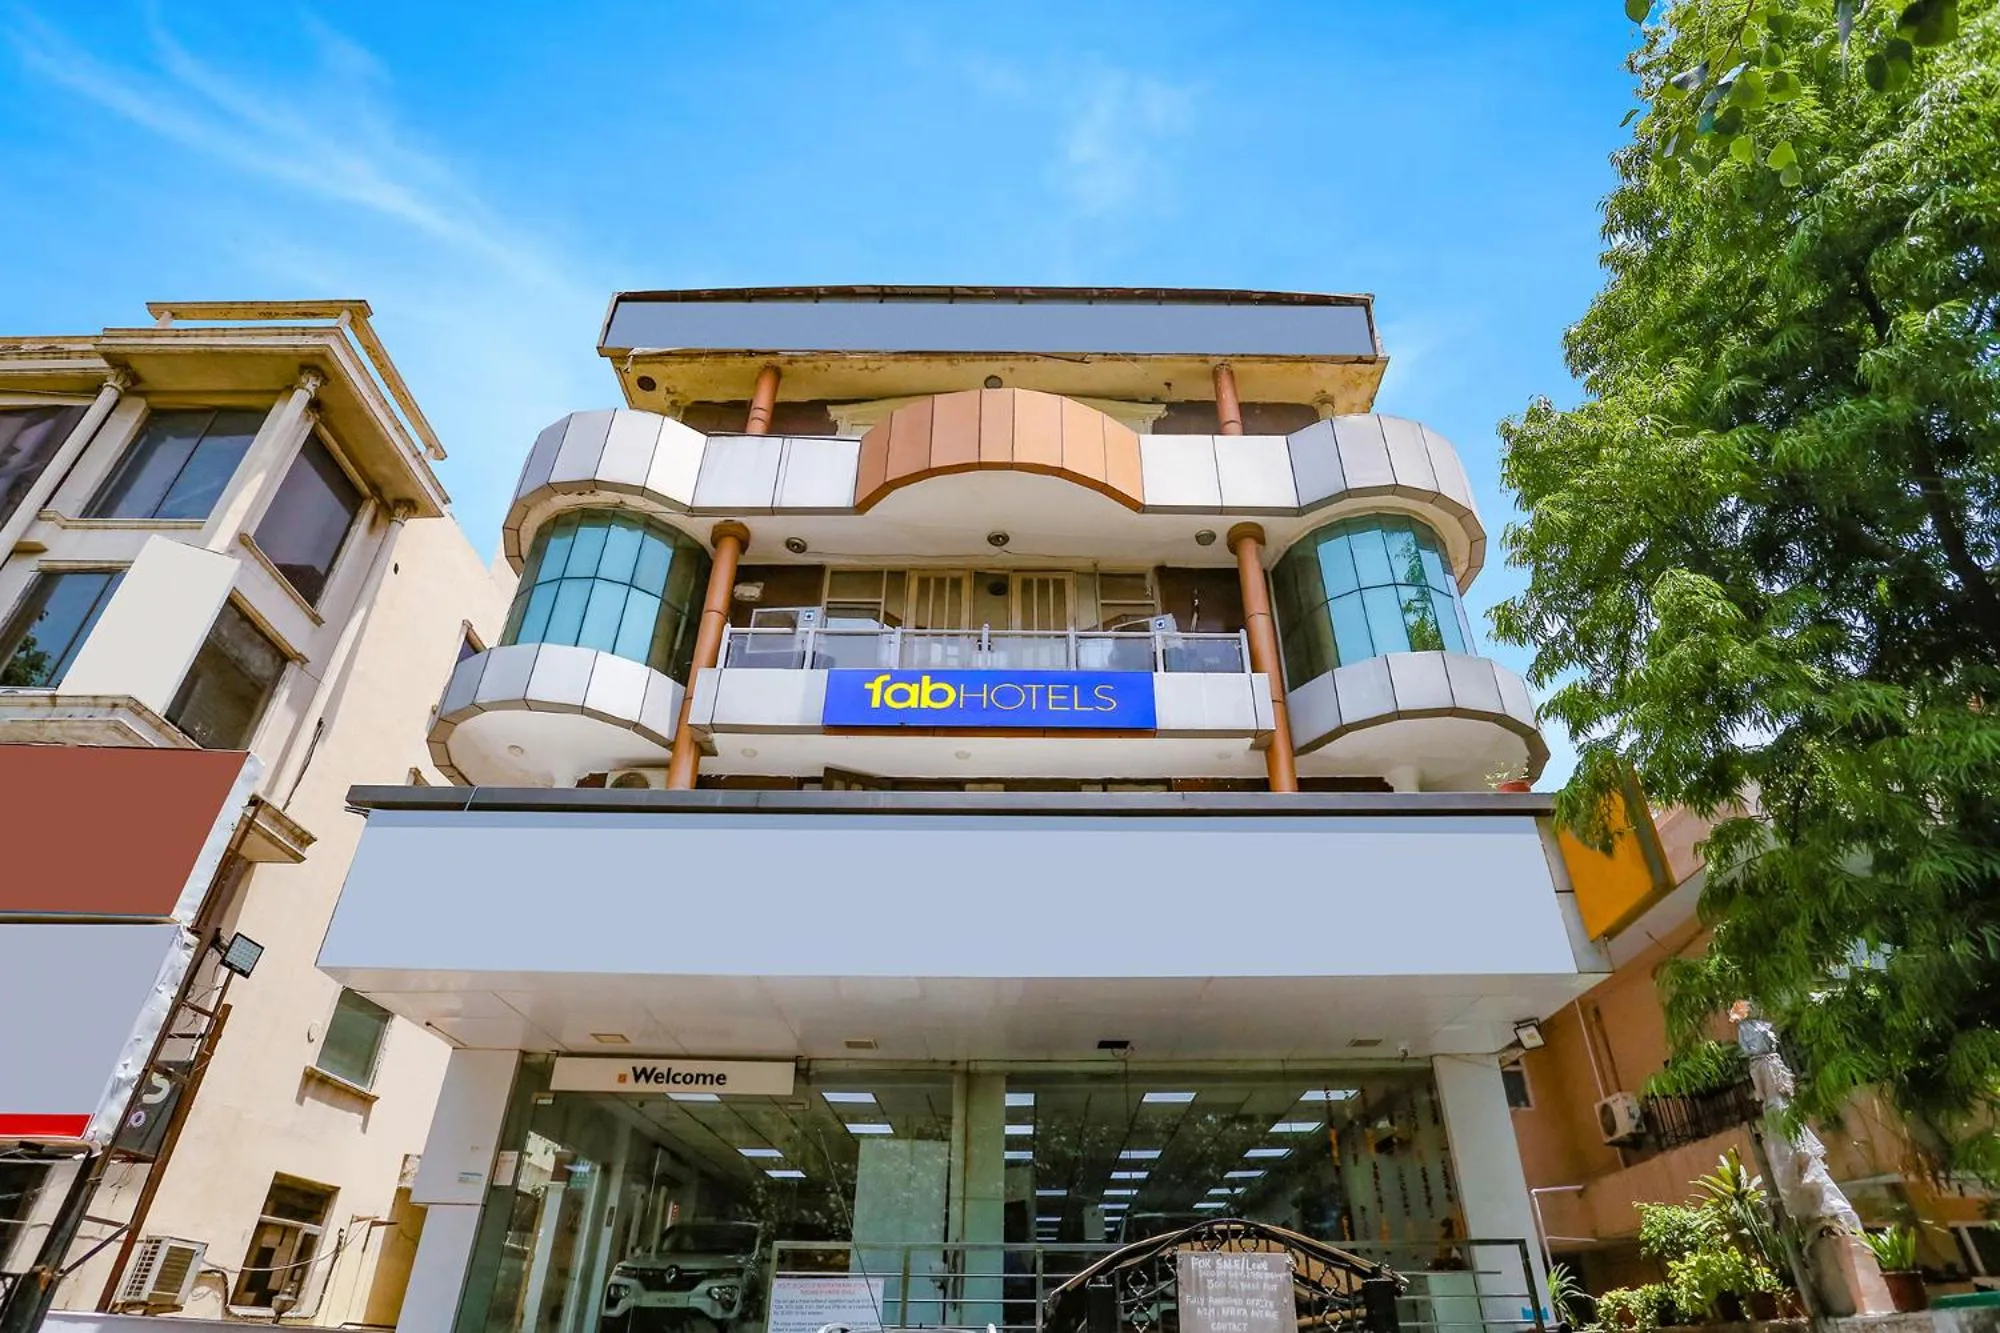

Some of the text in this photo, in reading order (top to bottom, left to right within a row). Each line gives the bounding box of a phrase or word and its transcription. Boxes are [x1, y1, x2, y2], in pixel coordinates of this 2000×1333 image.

[632, 1066, 727, 1085] Welcome
[1191, 1257, 1211, 1270] FOR
[1210, 1322, 1249, 1332] CONTACT
